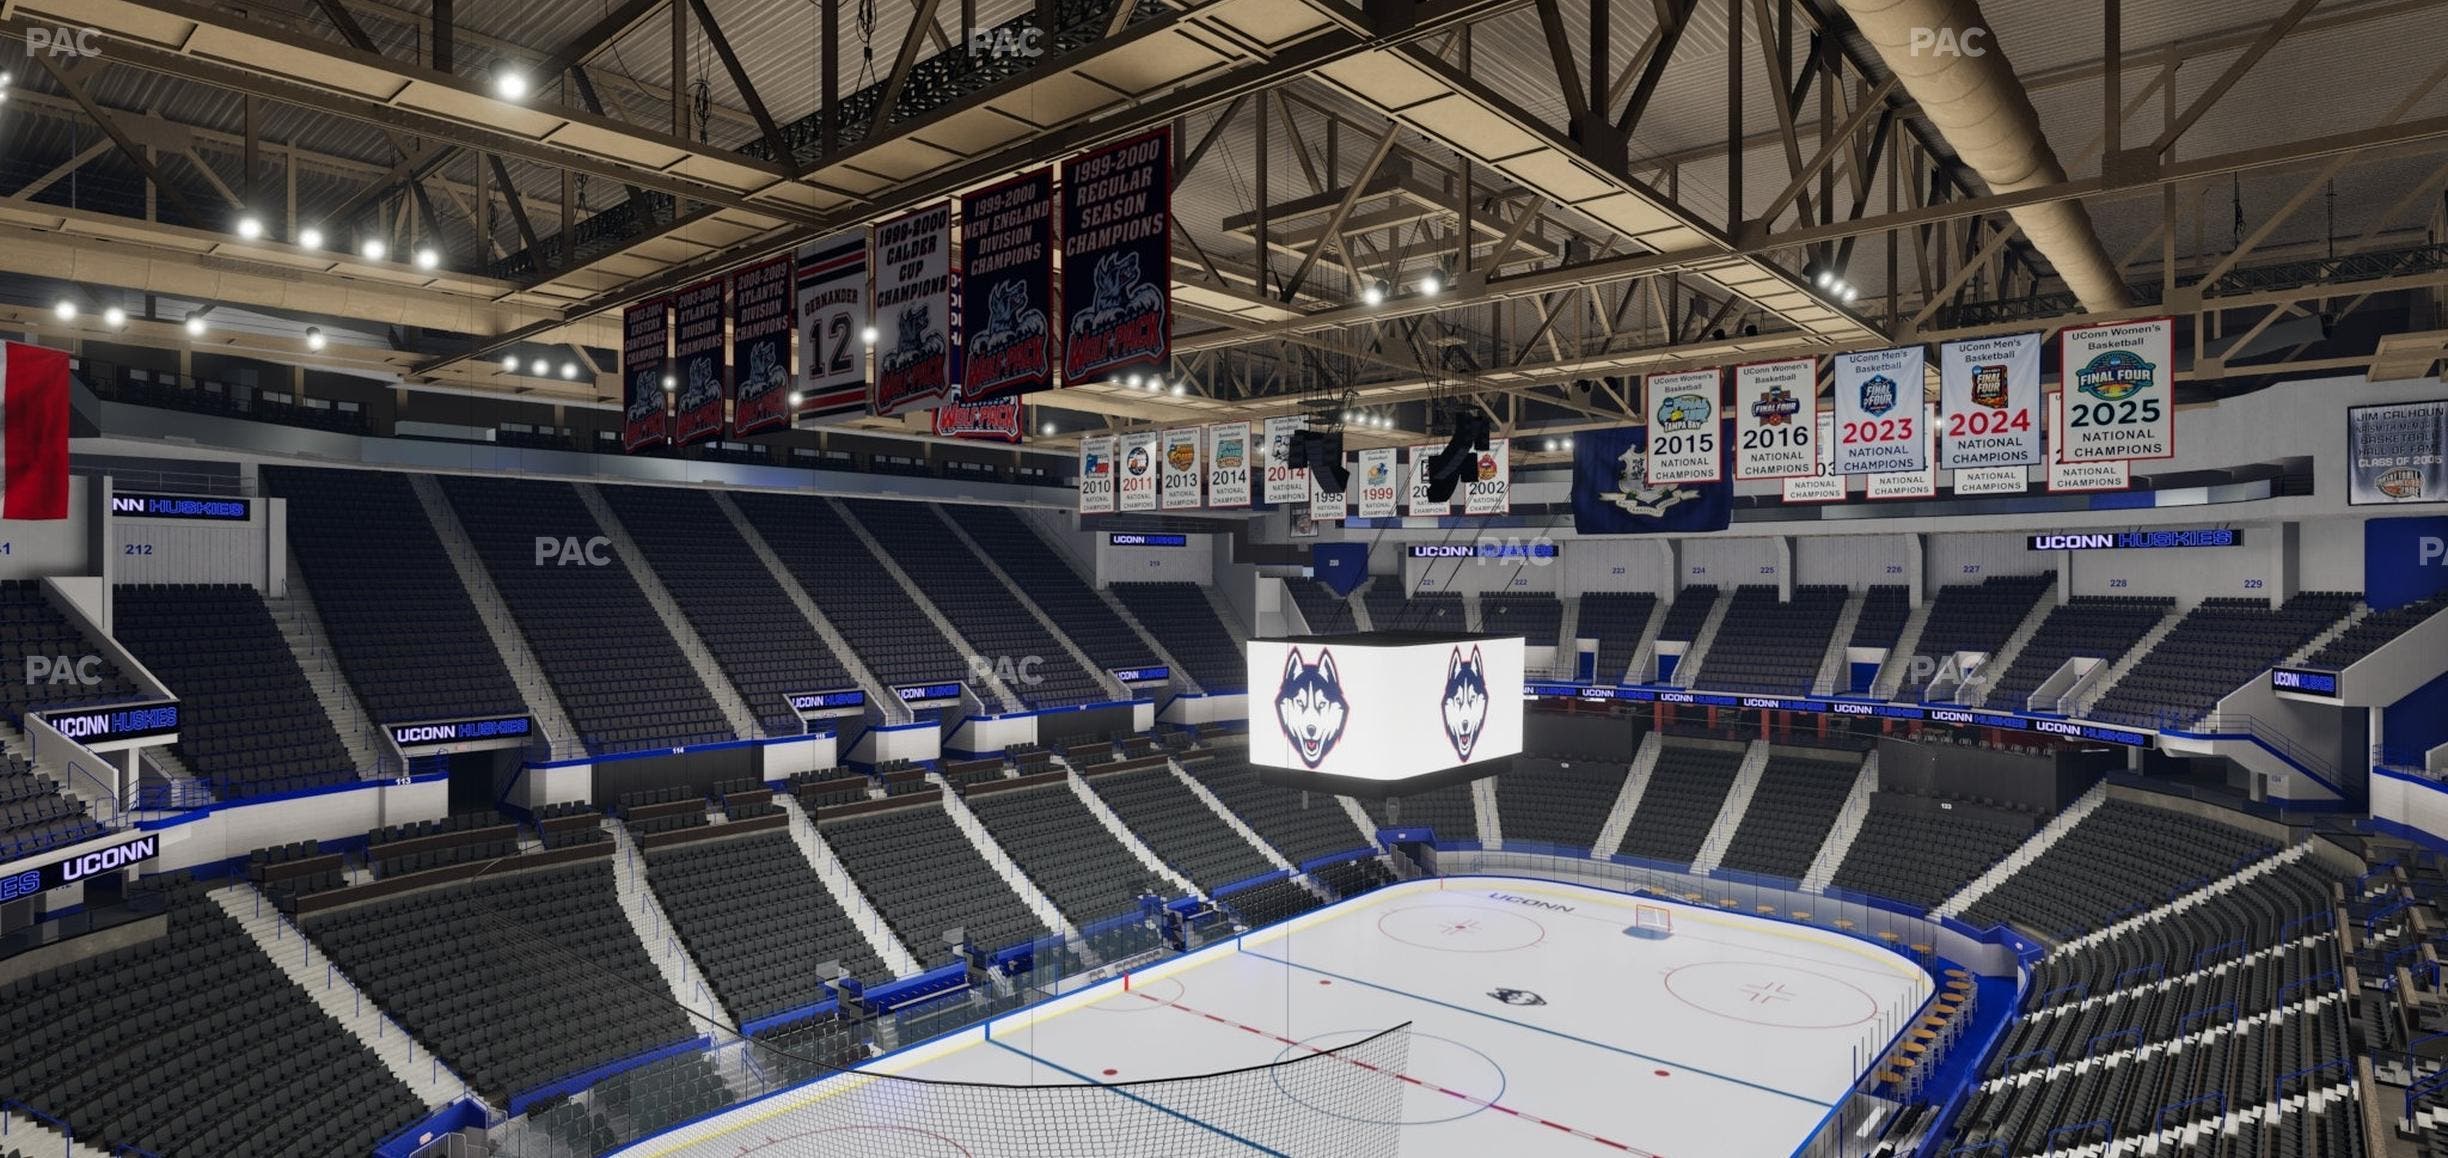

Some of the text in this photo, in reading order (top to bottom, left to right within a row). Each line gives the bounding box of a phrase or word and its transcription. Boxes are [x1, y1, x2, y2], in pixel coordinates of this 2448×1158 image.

[1074, 139, 1160, 184] 1999-2000
[1076, 167, 1153, 207] REGULAR
[975, 183, 1036, 217] 1999-2000
[1081, 193, 1147, 229] SEASON
[965, 200, 1049, 240] NEW ENGLAND
[979, 225, 1031, 255] DIVISION
[1066, 213, 1164, 257] CHAMPIONS
[887, 236, 938, 266] CALDER
[971, 243, 1041, 276] CHAMPIONS
[900, 260, 924, 282] CUP
[739, 280, 784, 307] ATLANTIC
[878, 275, 948, 308] CHAMPIONS
[680, 301, 718, 323] ATLANTIC
[741, 300, 781, 323] DIVISION
[682, 318, 716, 339] DIVISION
[735, 315, 788, 342] CHAMPIONS
[2072, 325, 2160, 340] UConn Women's
[677, 334, 722, 357] CHAMPIONS
[809, 312, 853, 380] 12
[1959, 339, 2021, 352] UConn Men's
[2088, 338, 2144, 350] Basketball
[1850, 351, 1908, 363] UConn Men's
[1965, 351, 2015, 363] Basketball
[1744, 364, 1808, 376] UConn Women's
[1856, 362, 1902, 373] Basketball
[1680, 373, 1713, 382] Women's
[1756, 374, 1796, 384] Basketball
[1977, 371, 2001, 384] FINAL
[2081, 369, 2151, 386] FINAL FOUR
[1665, 384, 1702, 393] Basketball
[1866, 385, 1891, 395] FINAL
[1977, 382, 2000, 394] FOUR
[1869, 393, 1892, 405] FOUR
[1755, 402, 1796, 414] FINAL FOUR
[2071, 399, 2160, 427] 2025
[2357, 408, 2443, 421] JIM CALHOUN
[1949, 409, 2030, 436] 2024
[1843, 418, 1912, 444] 2023
[2083, 430, 2155, 442] NATIONAL
[1654, 434, 1713, 455] 2015
[1743, 426, 1808, 450] 2016
[1958, 438, 2023, 449] NATIONAL
[1849, 447, 1909, 457] NATIONAL
[2075, 444, 2162, 457] CHAMPIONS
[1661, 458, 1709, 467] NATIONAL
[1751, 453, 1803, 462] NATIONAL
[1953, 451, 2028, 464] CHAMPIONS
[2359, 455, 2443, 467] CLASS OF 2005
[1745, 464, 1809, 475] CHAMPIONS
[1844, 458, 1913, 471] CHAMPIONS
[1212, 469, 1246, 485] 2014
[1656, 469, 1714, 480] CHAMPIONS
[1967, 471, 2016, 480] NATIONAL
[2063, 468, 2116, 476] NATIONAL
[1083, 480, 1111, 494] 2010
[1123, 476, 1152, 491] 2011
[1166, 473, 1197, 488] 2013
[1962, 482, 2021, 491] CHAMPIONS
[2057, 478, 2121, 487] CHAMPIONS
[1362, 488, 1394, 501] 1999
[1469, 481, 1505, 495] 2002
[1791, 490, 1840, 498] CHAMPIONS
[1875, 486, 1929, 495] CHAMPIONS
[149, 500, 245, 516] HUSKIES
[2036, 530, 2232, 549] UCONN HUSKIES
[125, 544, 153, 555] 212
[1414, 546, 1474, 557] UCONN
[1963, 565, 1980, 573] 227
[2110, 579, 2127, 588] 228
[2244, 580, 2262, 588] 229
[2274, 672, 2299, 687] UCONN
[1582, 688, 1614, 698] UCONN
[1661, 694, 1693, 703] UCONN
[1744, 698, 1779, 709] UCONN
[1834, 704, 1872, 715] UCONN
[1932, 711, 1973, 723] UCONN
[2036, 721, 2081, 736] UCONN
[53, 707, 177, 737] UCONN HUSKIES
[397, 725, 455, 743] UCONN
[63, 838, 153, 880] UCONN
[1488, 892, 1575, 912] UCONN
